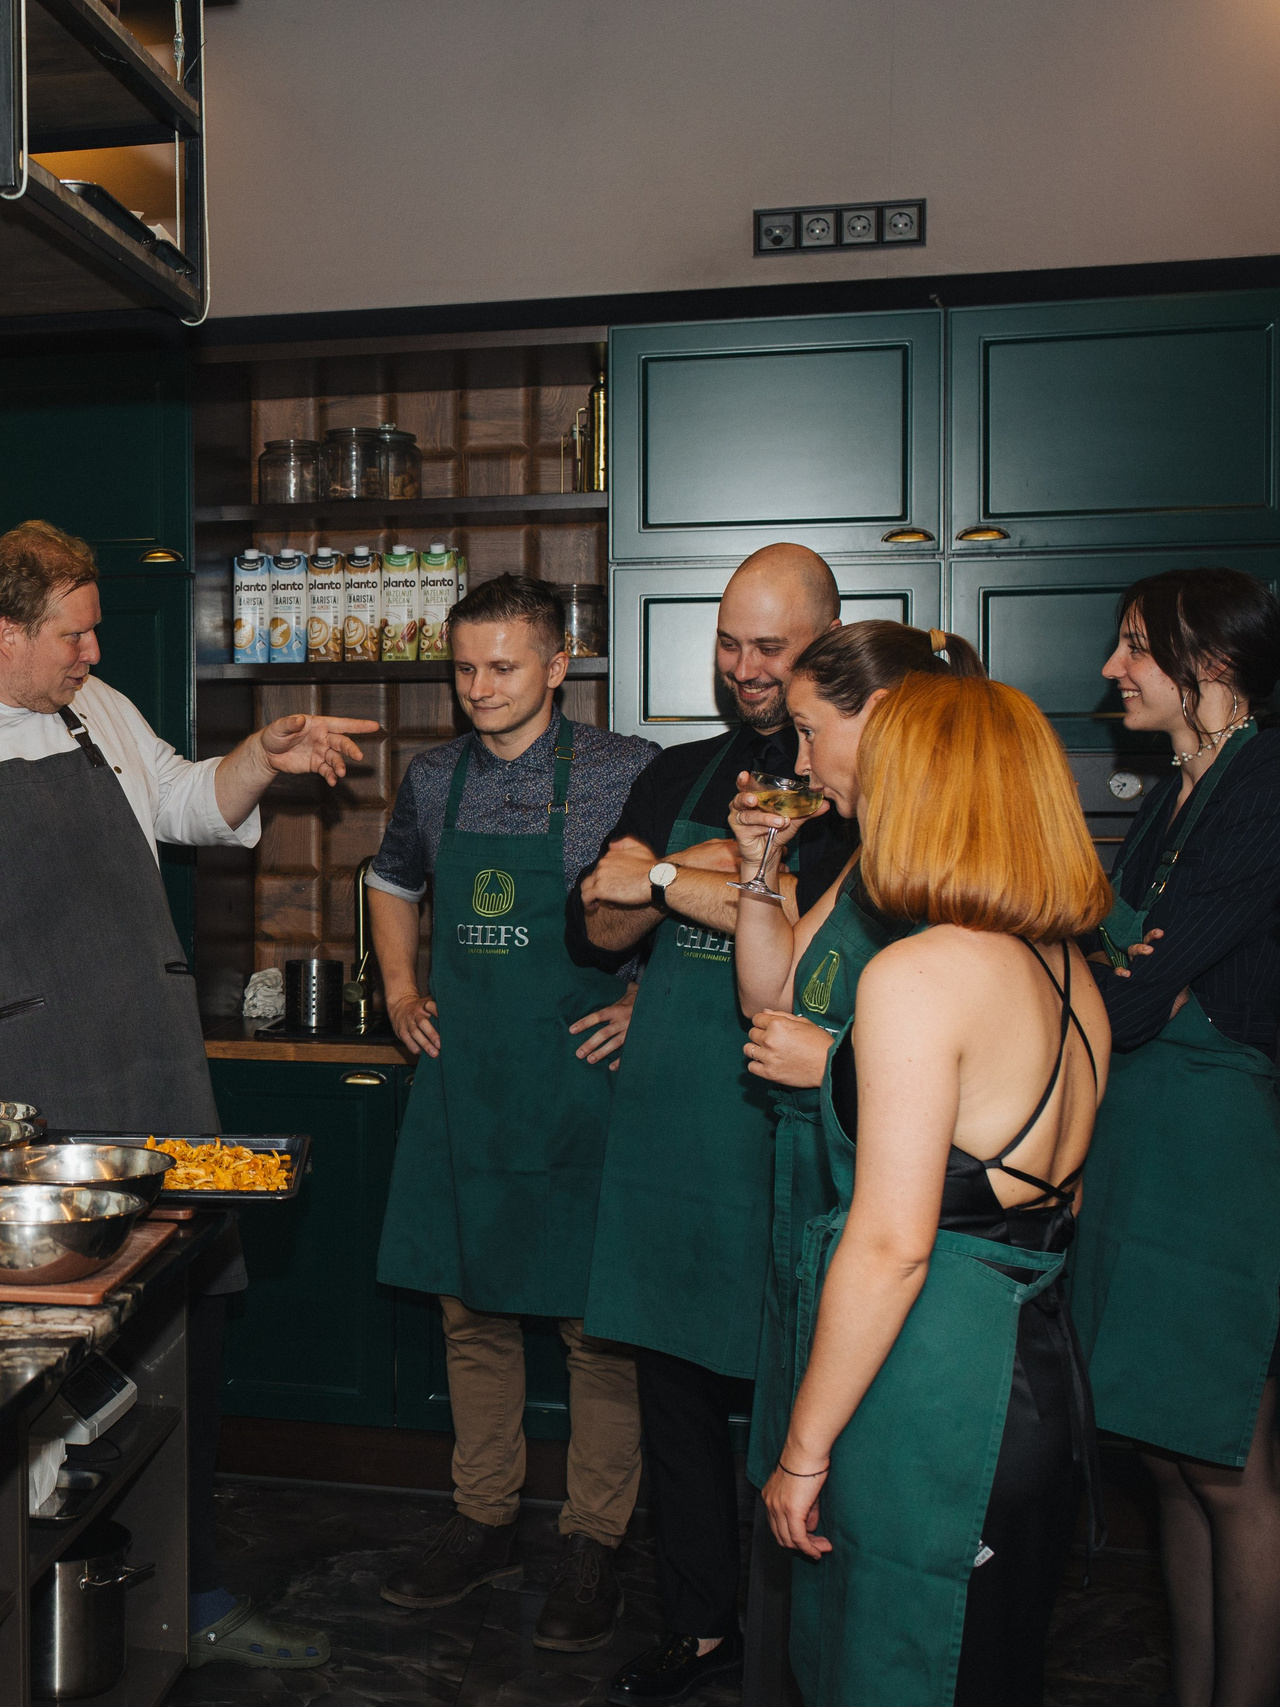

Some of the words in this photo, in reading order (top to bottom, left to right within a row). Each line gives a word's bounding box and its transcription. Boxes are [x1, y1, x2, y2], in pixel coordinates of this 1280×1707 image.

[235, 581, 267, 594] planto
[271, 580, 304, 593] planto
[308, 579, 342, 592] planto
[345, 578, 378, 591] planto
[383, 577, 416, 590] planto
[421, 576, 454, 590] planto
[275, 596, 299, 605] BARISTA
[312, 596, 337, 604] BARISTA
[348, 595, 373, 603] BARISTA
[457, 924, 530, 947] CHEFS
[676, 924, 735, 954] CHEF
